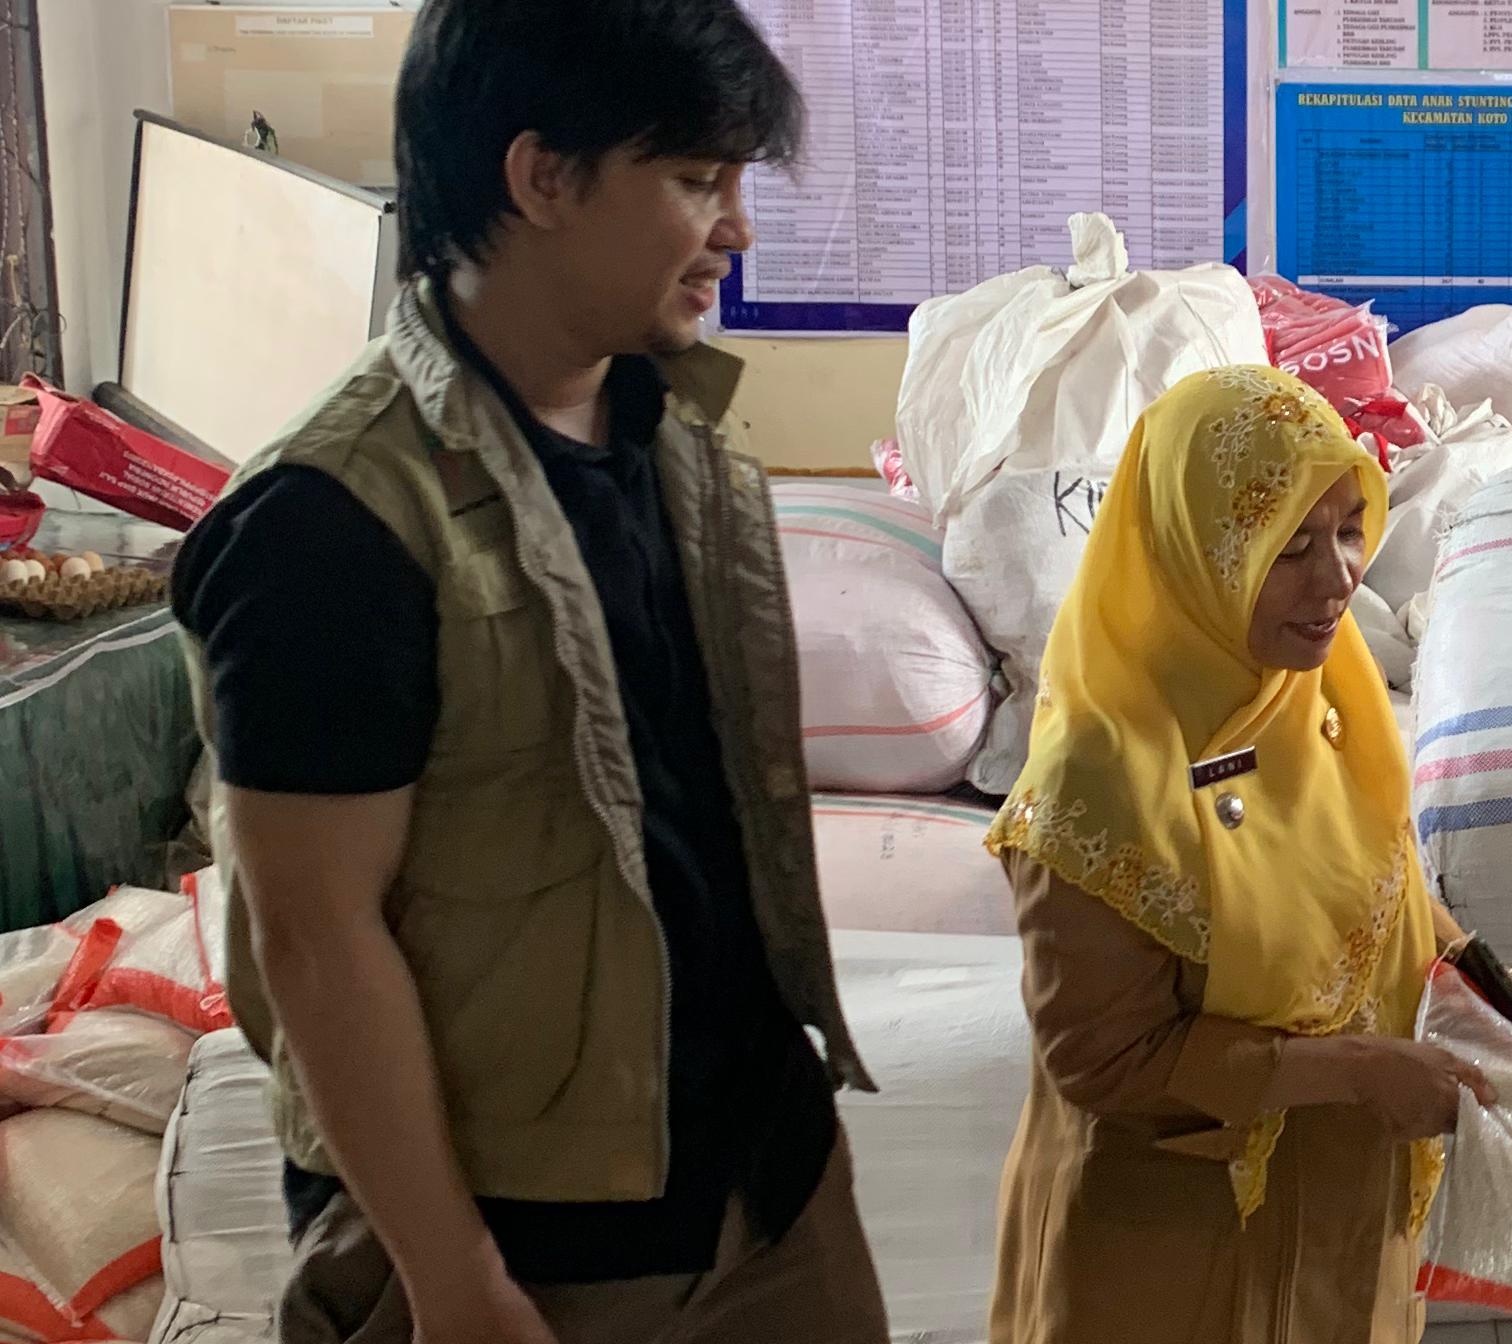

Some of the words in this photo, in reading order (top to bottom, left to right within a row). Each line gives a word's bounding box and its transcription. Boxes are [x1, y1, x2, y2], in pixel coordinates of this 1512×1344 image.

[1298, 93, 1383, 107] REKAPITULASI
[1388, 94, 1417, 108] DATA
[1422, 94, 1453, 108] ANAK
[1402, 111, 1473, 124] KECAMATAN
[1478, 112, 1504, 125] KOTO
